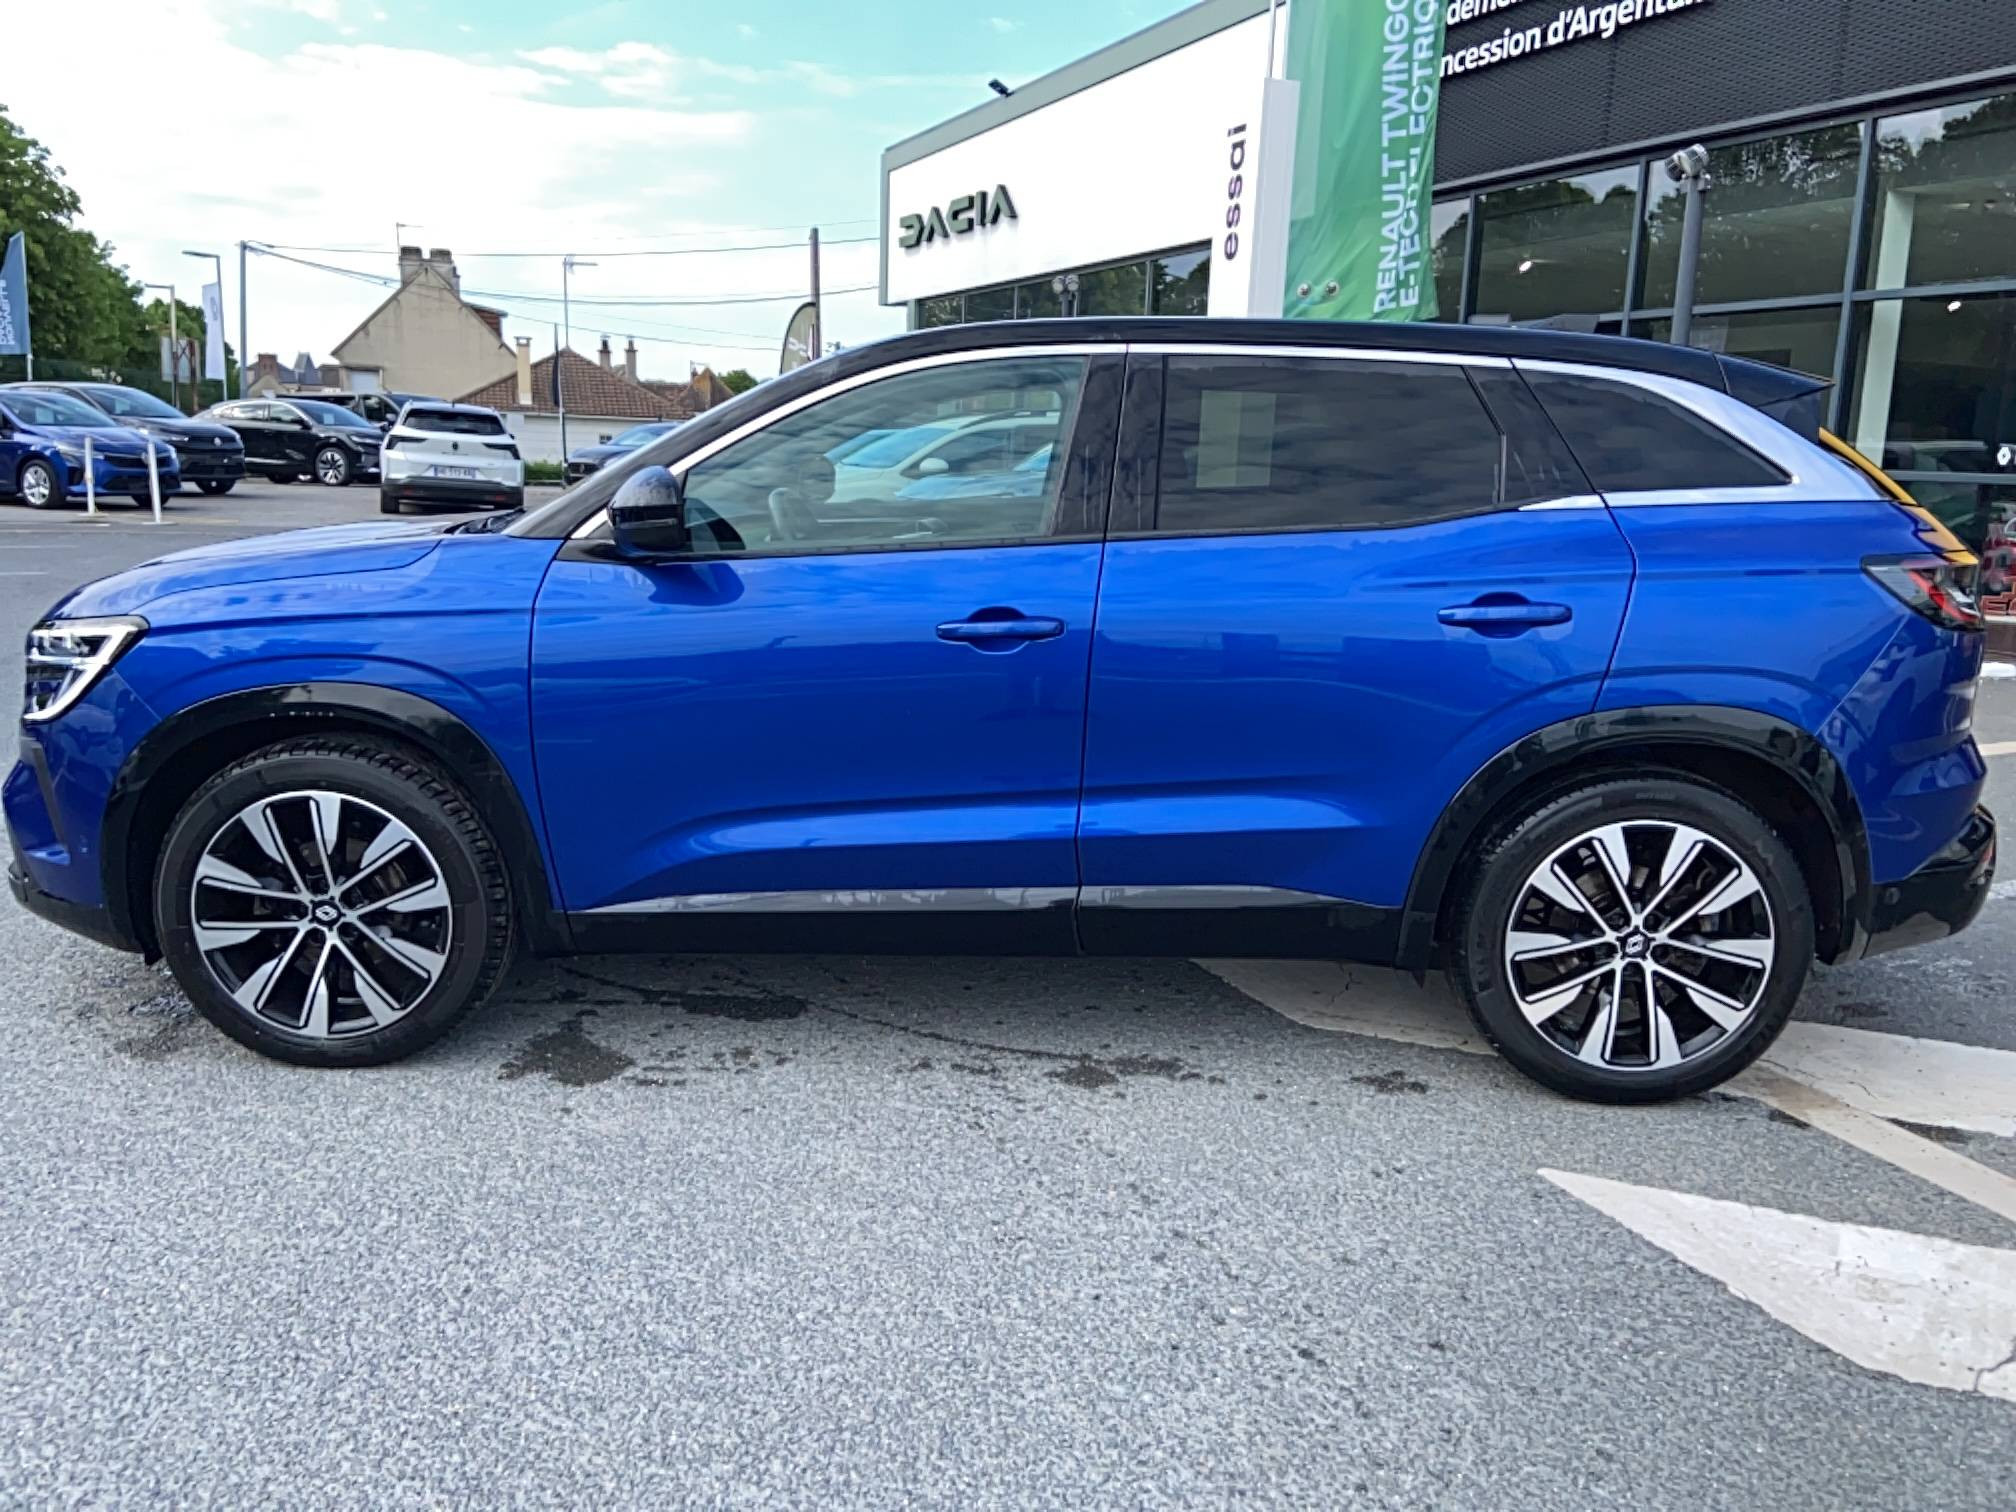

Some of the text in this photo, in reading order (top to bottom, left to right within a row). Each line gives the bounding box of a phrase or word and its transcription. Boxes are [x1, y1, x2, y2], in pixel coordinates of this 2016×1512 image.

[1439, 0, 1704, 77] ncession d'Argen
[898, 183, 1018, 249] DACIA
[1224, 123, 1247, 261] essai
[1374, 153, 1407, 313] RENAULT
